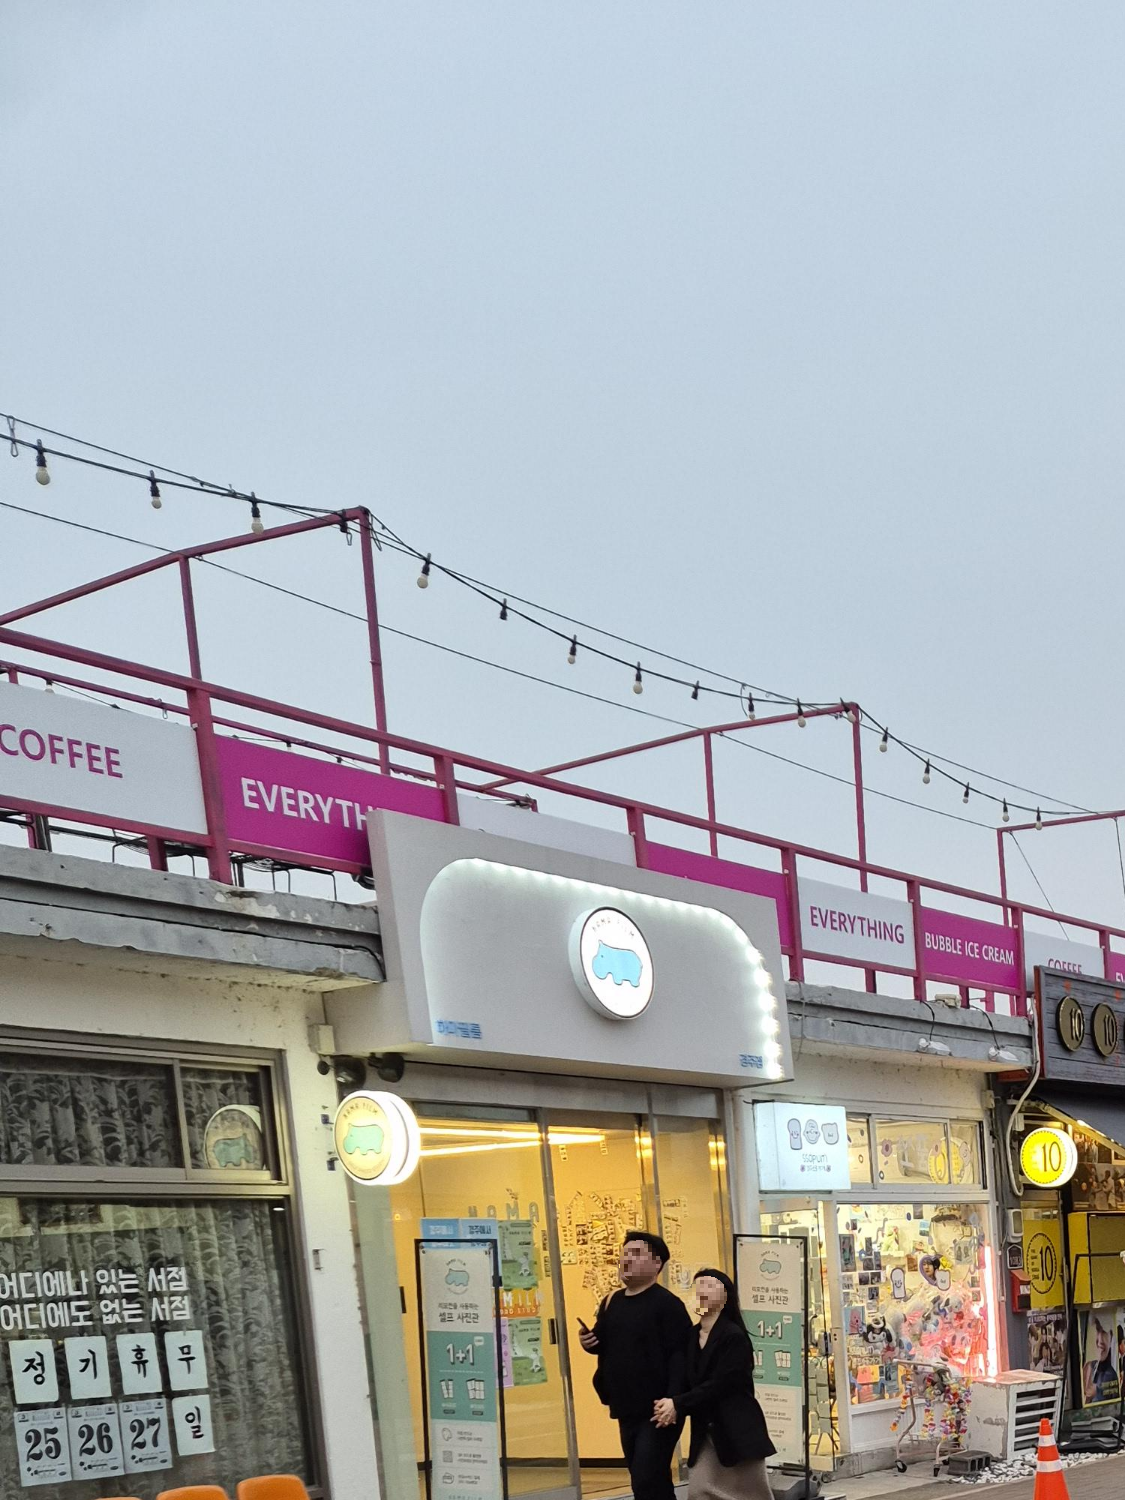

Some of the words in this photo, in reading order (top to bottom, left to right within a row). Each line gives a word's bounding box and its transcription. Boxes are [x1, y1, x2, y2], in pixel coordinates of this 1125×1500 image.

[0, 724, 123, 778] COFFEE
[241, 777, 380, 831] EVERYTH
[809, 906, 905, 944] EVERYTHING
[925, 932, 962, 956] BUBBLE
[964, 941, 980, 959] ICE
[982, 945, 1014, 966] CREAM
[1069, 1008, 1082, 1042] 10
[1103, 1014, 1117, 1047] 10
[1042, 1141, 1061, 1172] 10
[1040, 1246, 1053, 1281] 10
[0, 1270, 88, 1299] 어디에나
[96, 1268, 139, 1294] 있는
[148, 1266, 189, 1292] 서점
[0, 1301, 93, 1331] 어디에도
[100, 1298, 143, 1325] 없는
[151, 1295, 191, 1322] 서점
[457, 1312, 479, 1323] 사진관
[757, 1320, 783, 1340] 1+1
[447, 1343, 475, 1365] 1+1
[25, 1426, 62, 1462] 25
[77, 1422, 113, 1457] 26
[129, 1417, 161, 1450] 27
